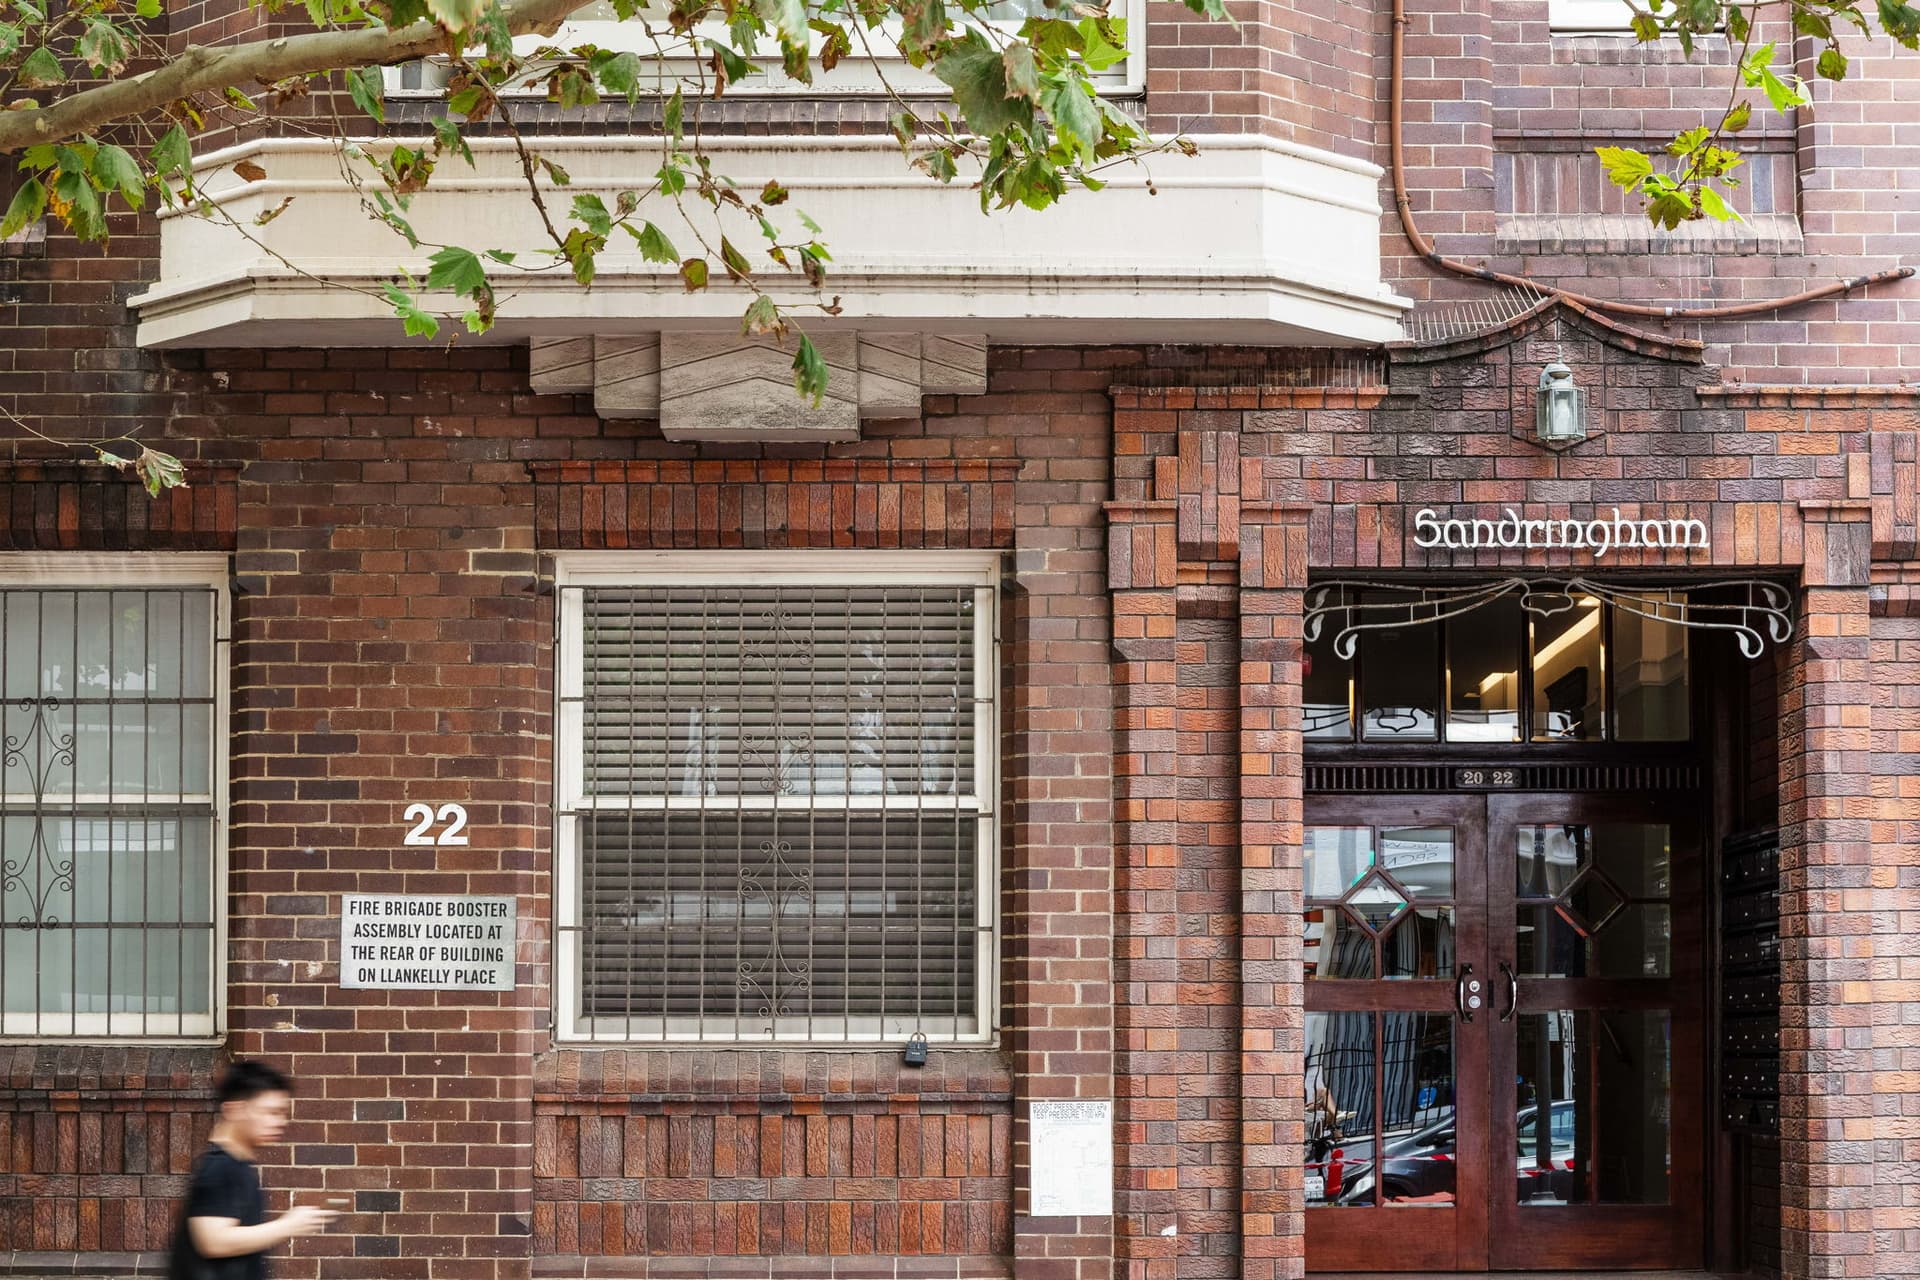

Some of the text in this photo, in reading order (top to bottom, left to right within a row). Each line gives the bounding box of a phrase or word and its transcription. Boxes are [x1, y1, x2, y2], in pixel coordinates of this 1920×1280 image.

[1413, 507, 1711, 557] Sandringham
[1463, 771, 1513, 785] 20 22
[403, 803, 468, 846] 22
[349, 900, 508, 918] FIRE BRIGADE BOOSTER
[353, 923, 503, 940] ASSEMBLY LOCATED AT
[351, 945, 504, 962] THE REAR OF BUILDING
[358, 967, 496, 985] ON LLANKELLY PLACE
[1032, 1103, 1052, 1112] BOOST
[1054, 1103, 1085, 1111] PRESSURE
[1032, 1111, 1048, 1120] TEST
[1049, 1111, 1080, 1120] PRESSURE
